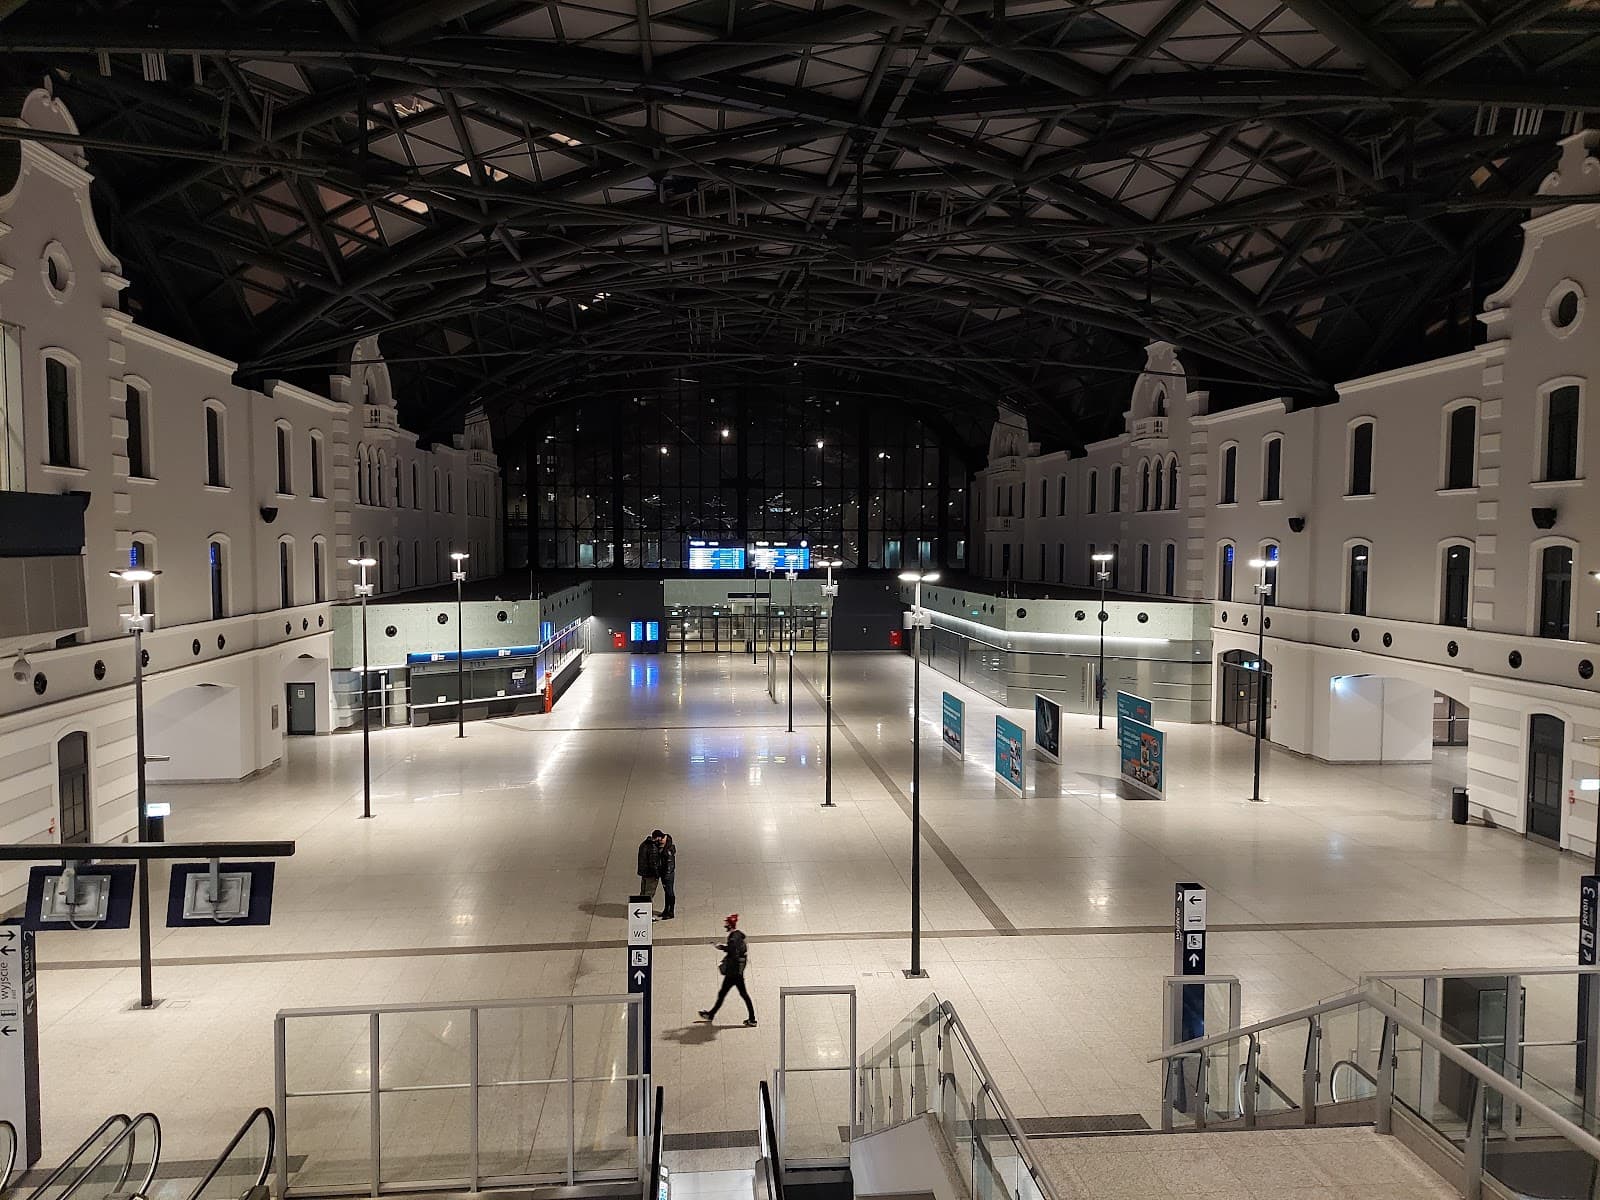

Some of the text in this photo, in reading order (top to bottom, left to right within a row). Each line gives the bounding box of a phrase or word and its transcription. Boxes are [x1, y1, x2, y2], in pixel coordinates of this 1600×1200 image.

[1583, 886, 1595, 898] 3
[24, 931, 34, 940] 2
[633, 930, 647, 938] WC
